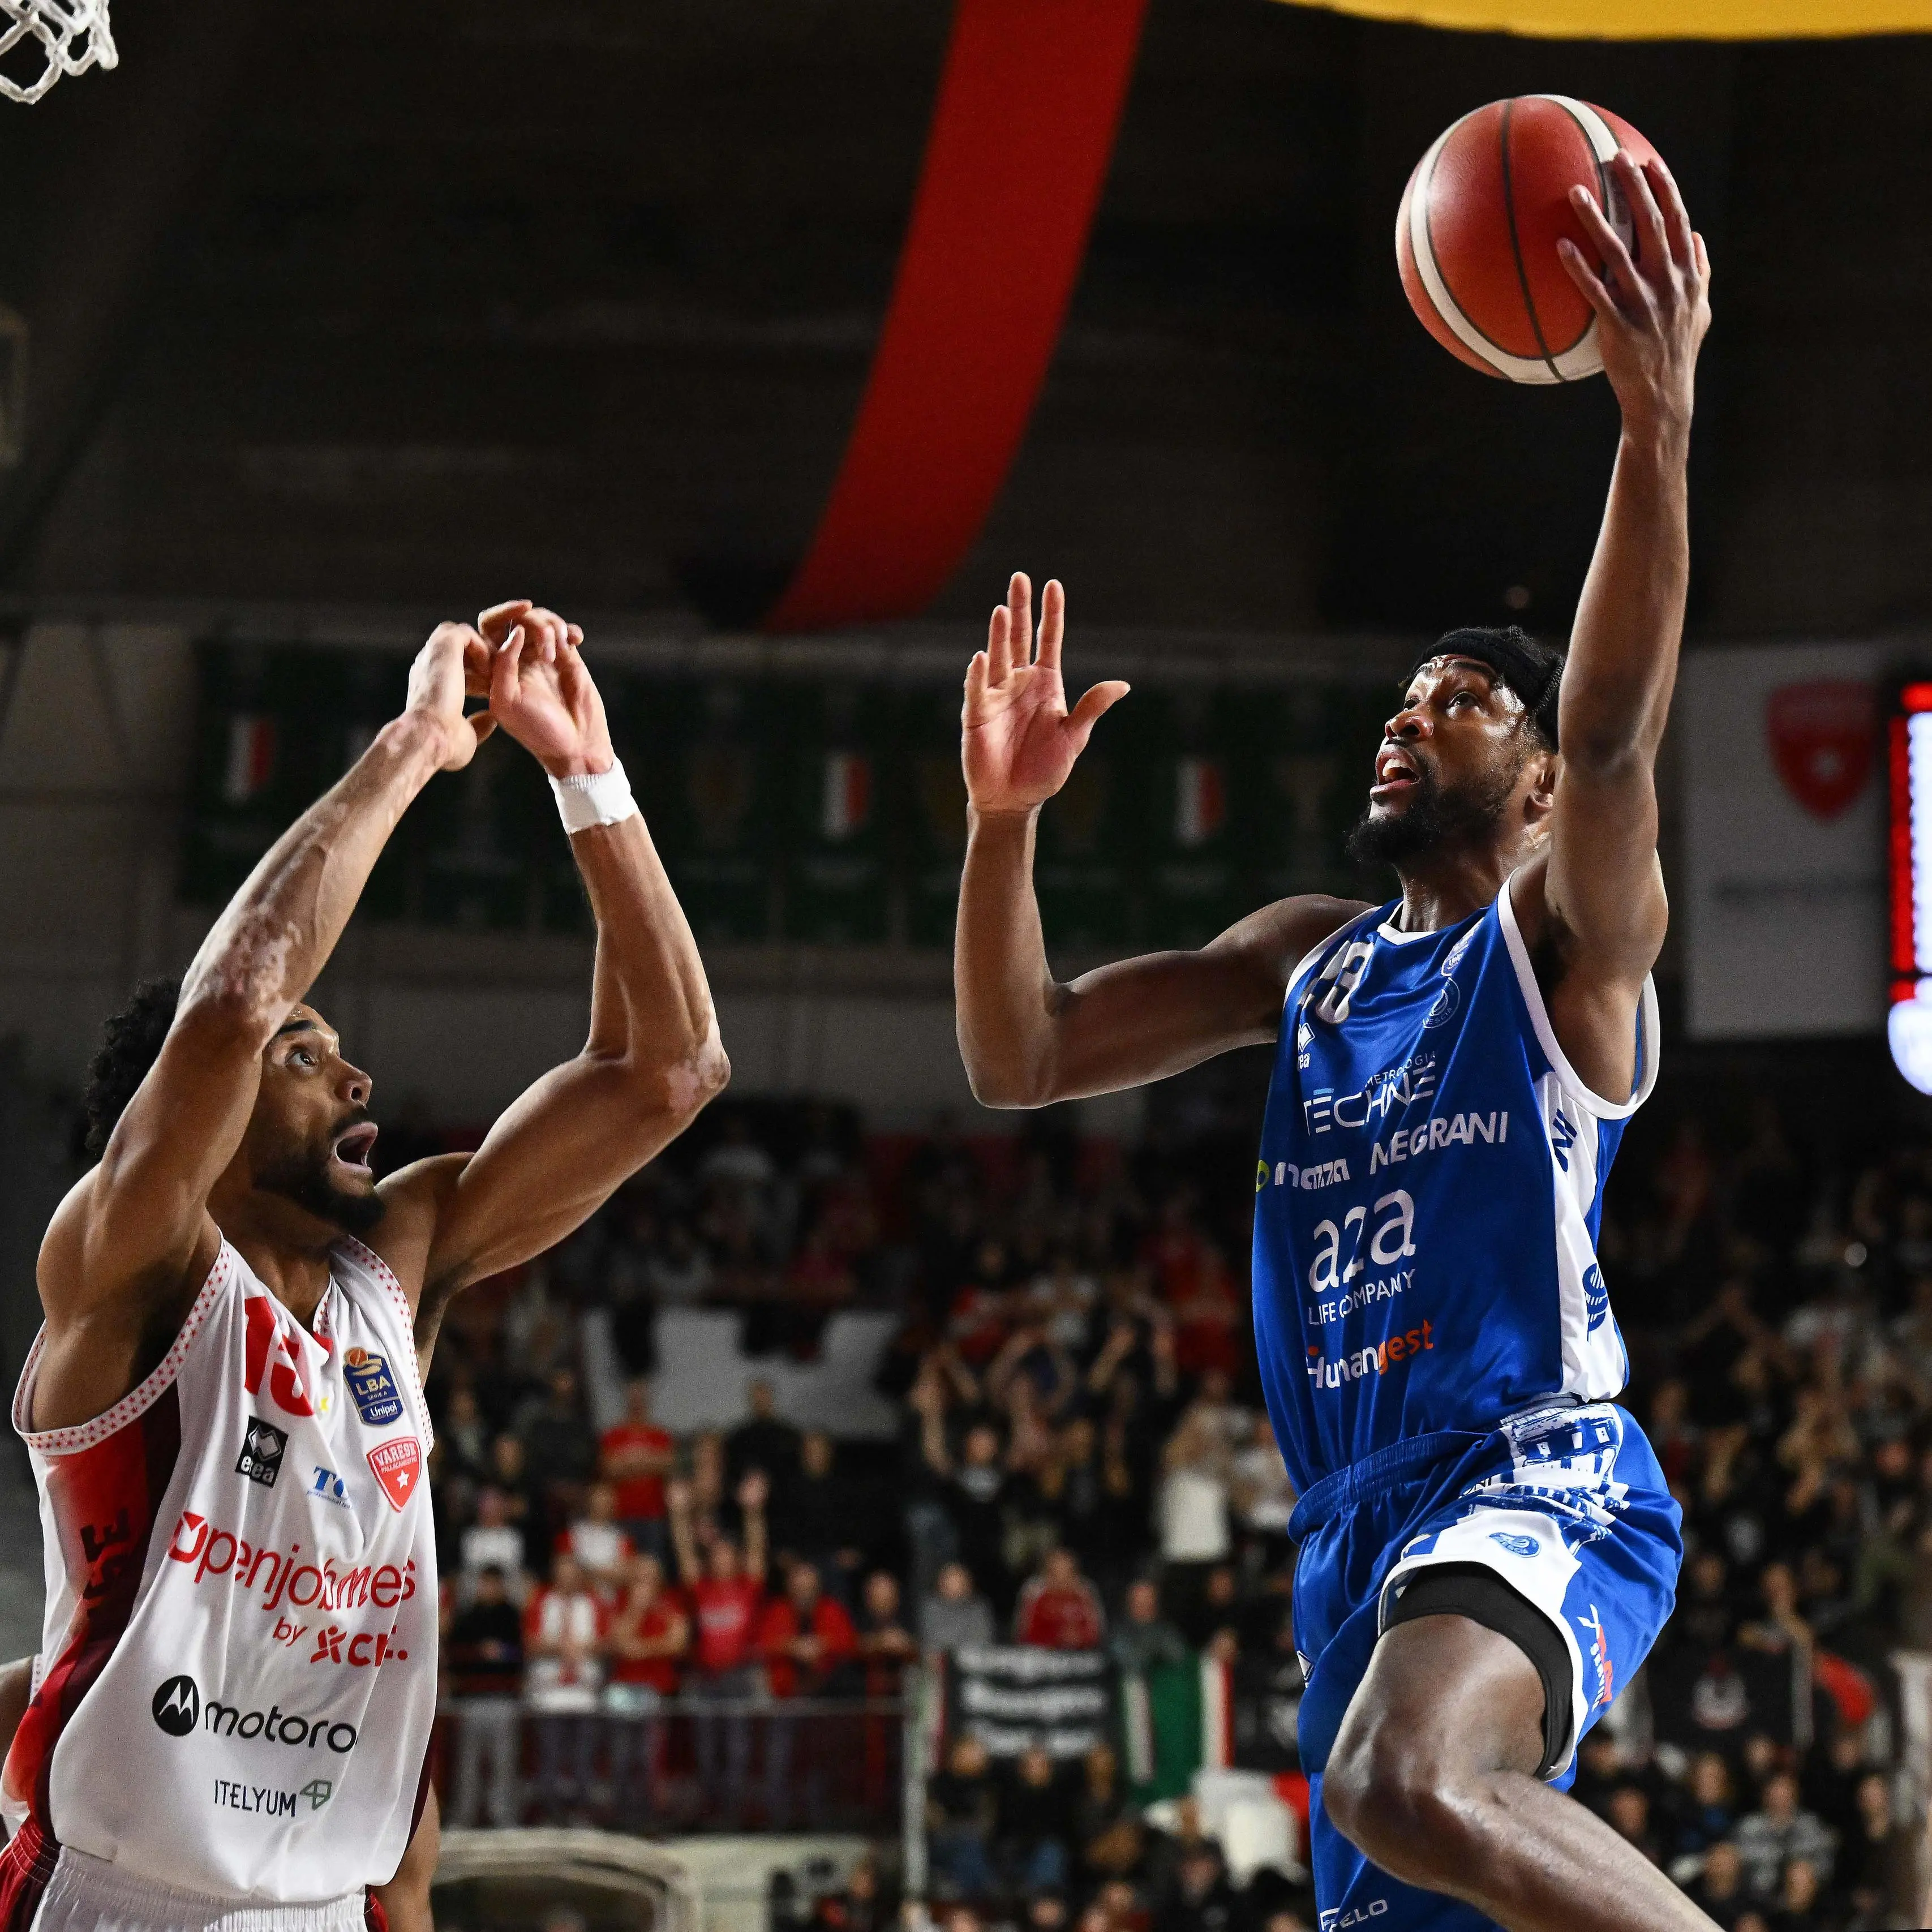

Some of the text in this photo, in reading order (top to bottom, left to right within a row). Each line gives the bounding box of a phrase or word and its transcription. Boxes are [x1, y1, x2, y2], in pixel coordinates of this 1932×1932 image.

[1370, 1111, 1508, 1175] NEGRANI
[1308, 1189, 1416, 1292] a2a
[1308, 1302, 1336, 1325] LIFE
[355, 1375, 391, 1396] LBA
[370, 1401, 397, 1417] Unipol
[375, 1443, 417, 1466] VARESE
[273, 1616, 308, 1647] by
[215, 1779, 297, 1817] ITELYUM
